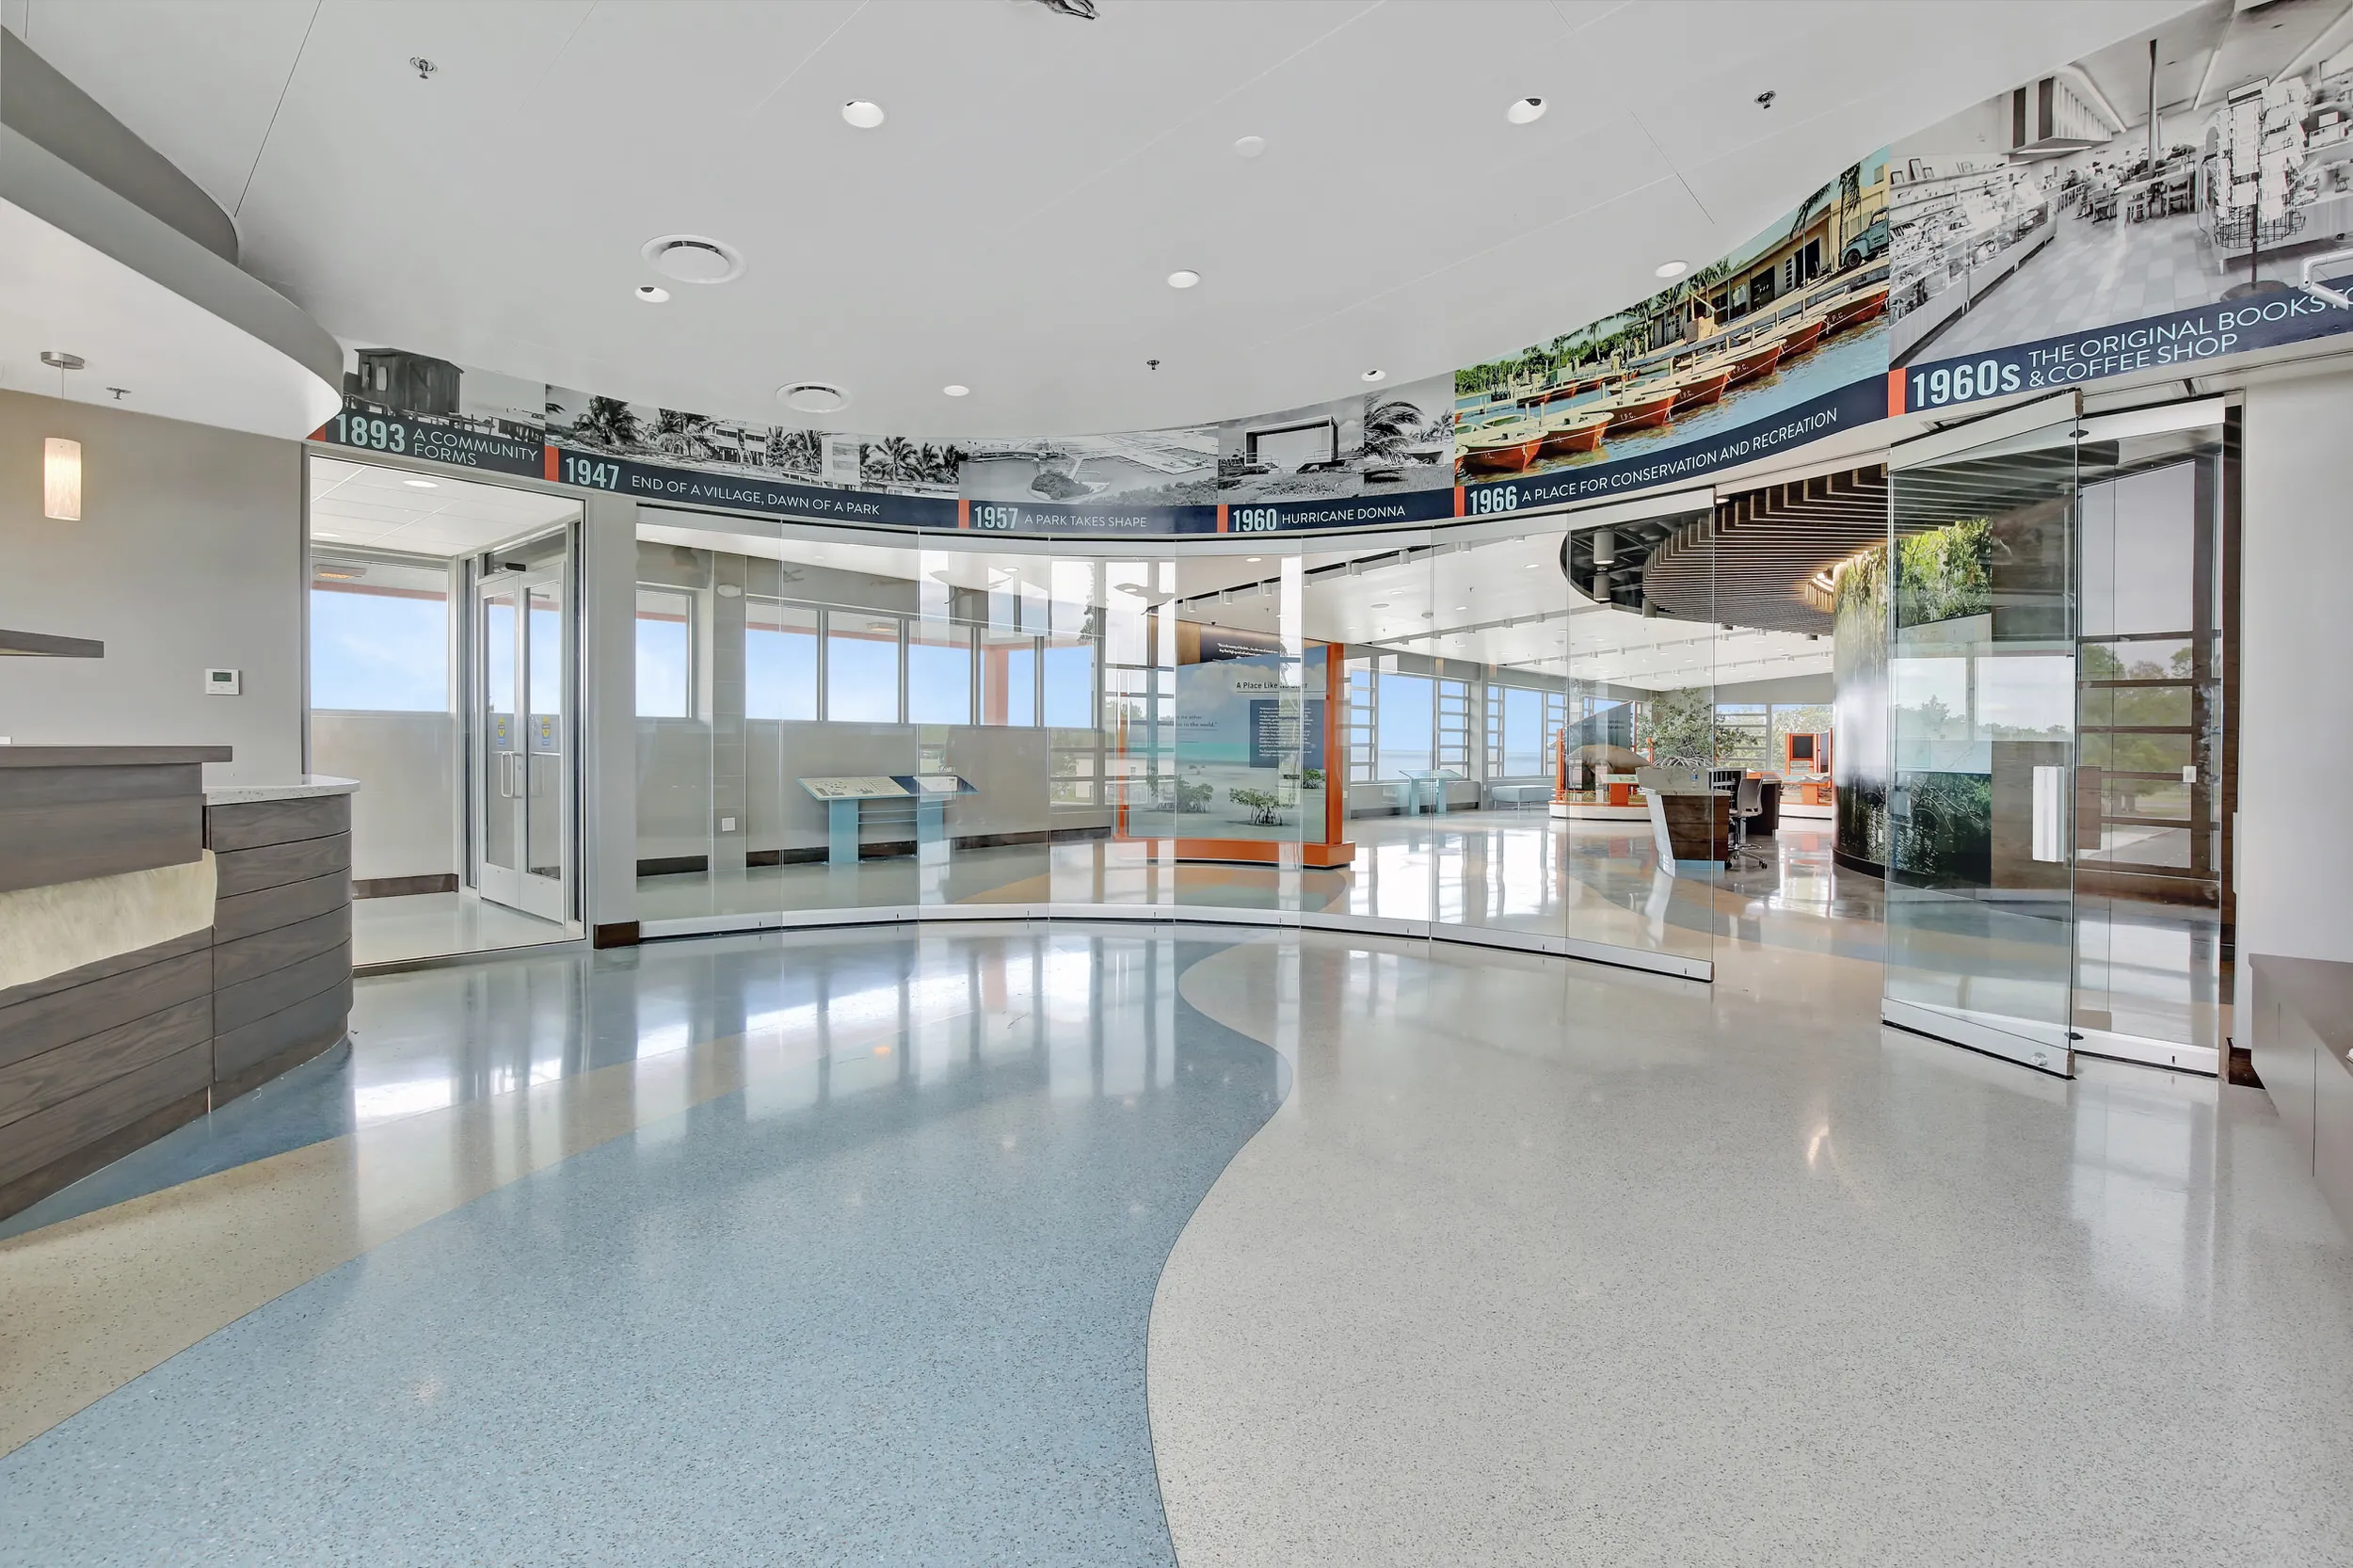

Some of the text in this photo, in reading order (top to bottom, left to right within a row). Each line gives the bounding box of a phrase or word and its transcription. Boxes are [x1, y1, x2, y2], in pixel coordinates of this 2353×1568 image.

[2027, 344, 2075, 369] THE
[2080, 317, 2214, 358] ORIGINAL
[2157, 333, 2239, 365] SHOP
[1913, 360, 2021, 408] 1960s
[335, 413, 406, 453] 1893
[412, 428, 538, 462] A COMMUNITY
[414, 443, 477, 467] FORMS
[1469, 407, 1837, 515] 1966 A PLACE FOR CONSERVATION AND RECREATION
[566, 456, 881, 516] 1947 END OF A VILLAGE, DAWN OF A PARK
[974, 506, 1147, 529] 1957 A PARK TAKES SHAPE
[1233, 505, 1406, 532] 1960 HURRICANE DONNA
